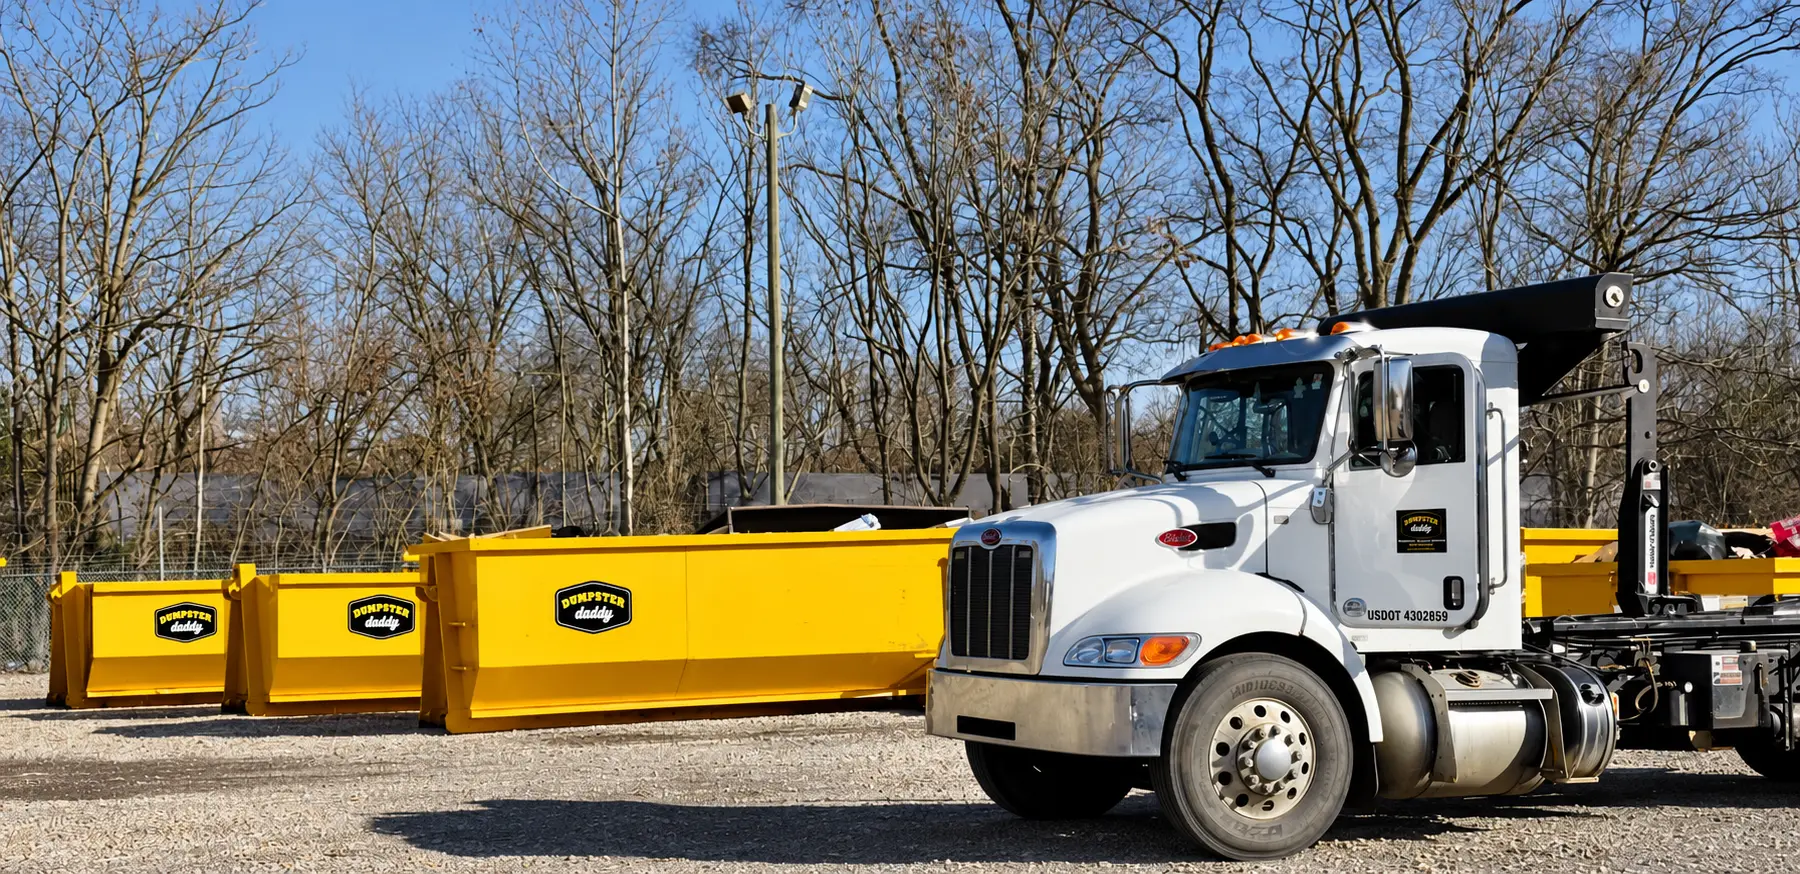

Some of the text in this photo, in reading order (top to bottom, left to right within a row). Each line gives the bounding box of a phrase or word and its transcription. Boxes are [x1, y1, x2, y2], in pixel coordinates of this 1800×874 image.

[561, 591, 625, 609] DUMPSTER
[159, 610, 212, 625] DUMPSTER
[352, 603, 410, 619] DUMPSTER
[574, 605, 615, 624] daddy
[1367, 610, 1449, 622] USDOT 4302859
[170, 620, 204, 635] daddy
[364, 615, 400, 631] daddy
